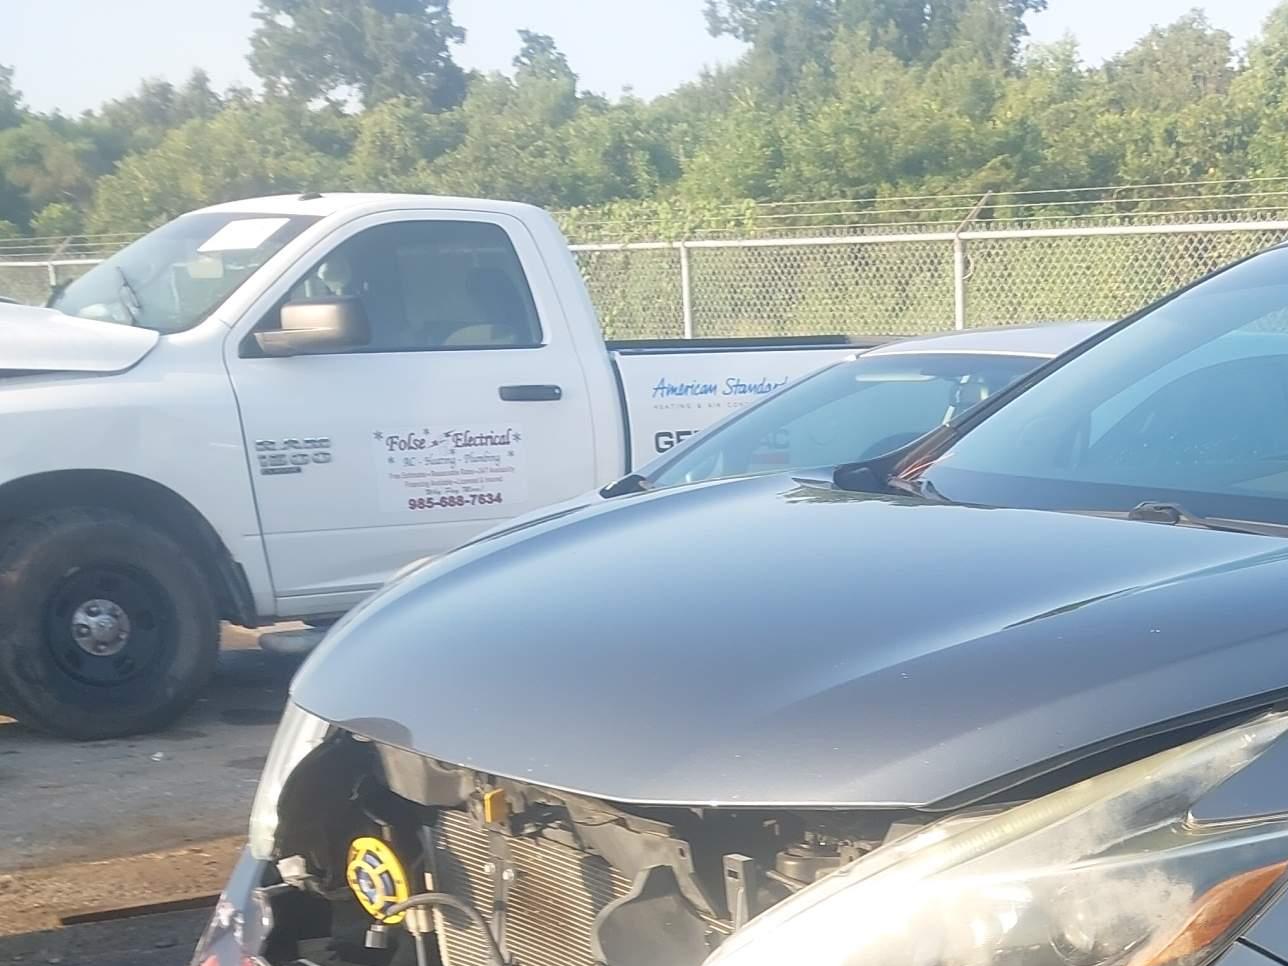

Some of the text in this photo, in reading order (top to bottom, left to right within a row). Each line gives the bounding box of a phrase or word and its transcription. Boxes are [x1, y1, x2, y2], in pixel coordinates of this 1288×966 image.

[652, 377, 718, 399] American
[386, 428, 512, 451] Folse Electrical
